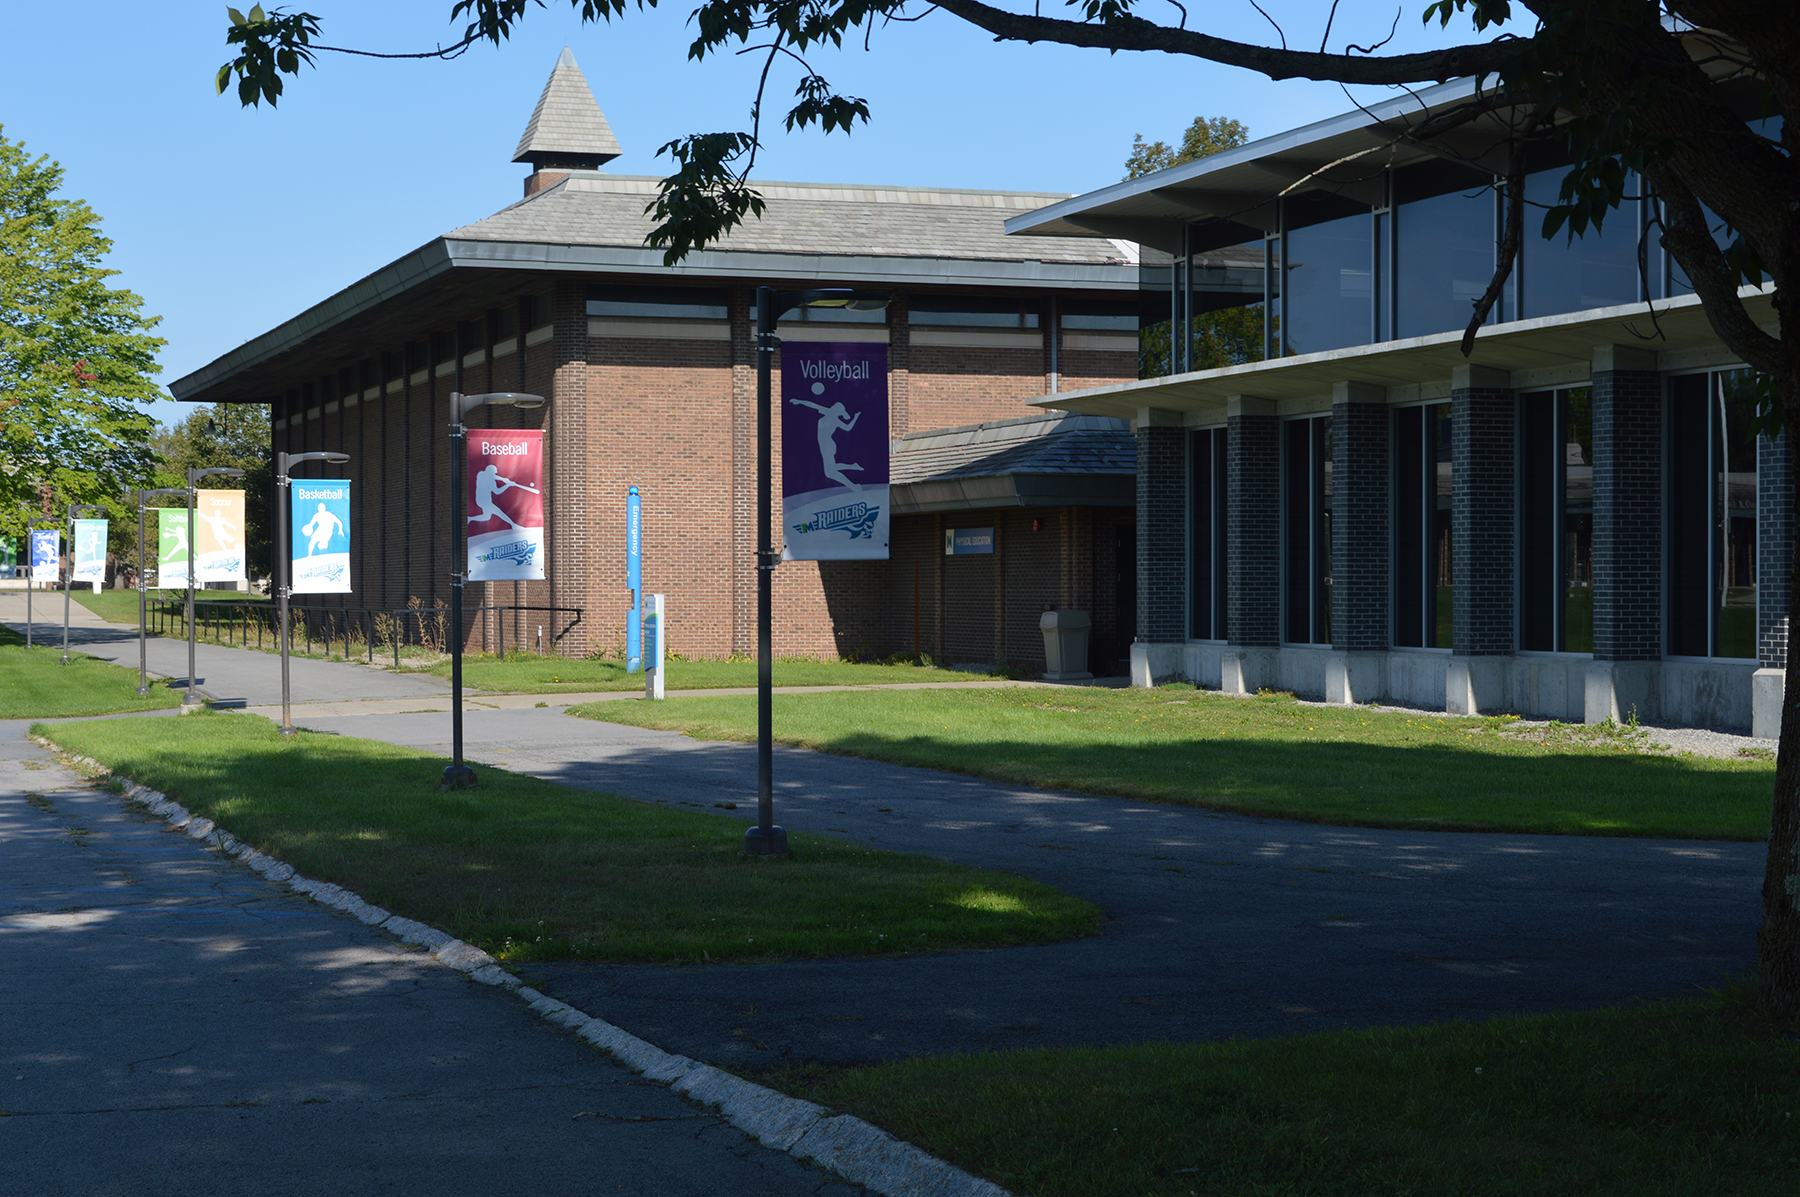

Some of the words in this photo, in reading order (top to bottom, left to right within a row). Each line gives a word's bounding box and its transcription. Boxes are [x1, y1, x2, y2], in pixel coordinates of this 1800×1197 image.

[800, 359, 869, 383] Volleyball
[482, 441, 528, 456] Baseball
[209, 497, 233, 507] Soccer
[299, 488, 343, 500] Basketball
[168, 514, 189, 523] Softba
[816, 502, 866, 529] RAIDERS
[630, 505, 640, 556] Emergency
[493, 540, 528, 559] RAIDERS
